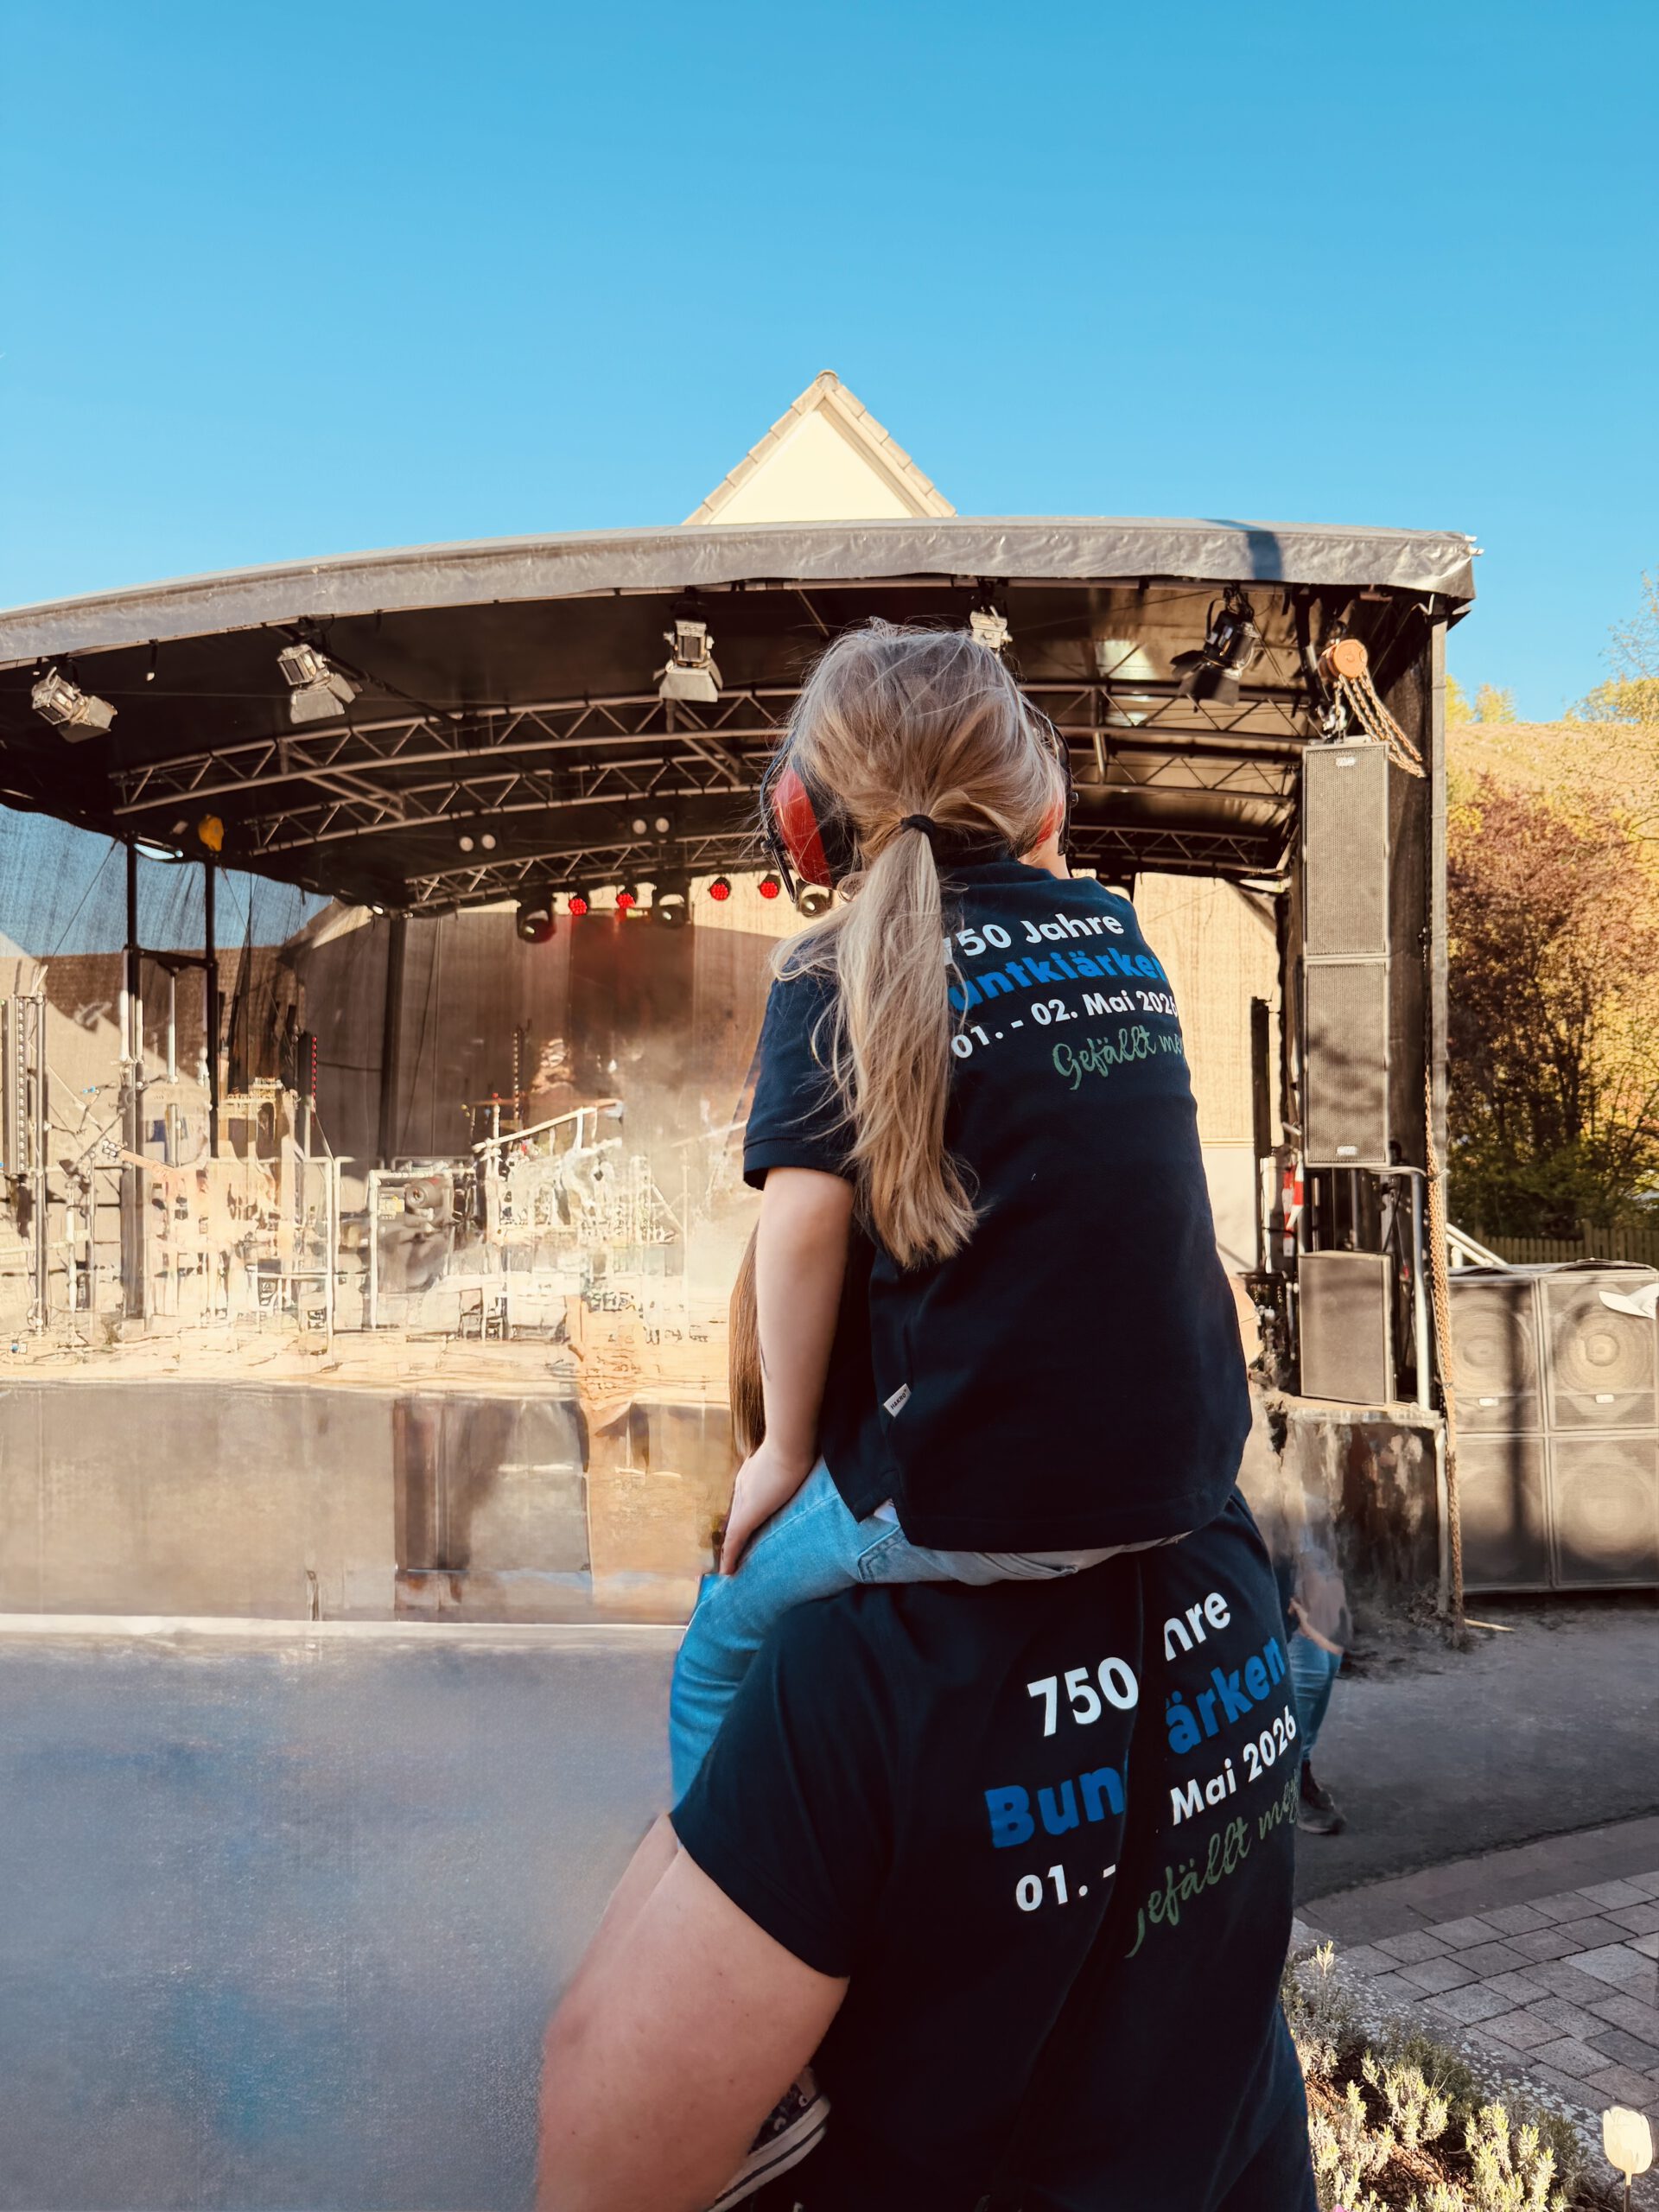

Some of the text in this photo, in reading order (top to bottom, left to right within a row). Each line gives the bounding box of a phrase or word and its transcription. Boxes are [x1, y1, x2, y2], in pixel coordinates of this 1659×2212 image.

[1020, 913, 1124, 944] Jahre
[949, 947, 1166, 1012] untkiärke
[951, 1025, 1004, 1058] 01.
[1031, 999, 1078, 1026] 02.
[1082, 990, 1135, 1016] Mai
[1135, 990, 1178, 1018] 2026
[1052, 1025, 1157, 1090] Gefällt
[1027, 1656, 1139, 1737] 750
[1015, 1864, 1089, 1911] 01.
[1170, 1758, 1236, 1826] Mai
[1243, 1705, 1296, 1783] 2026
